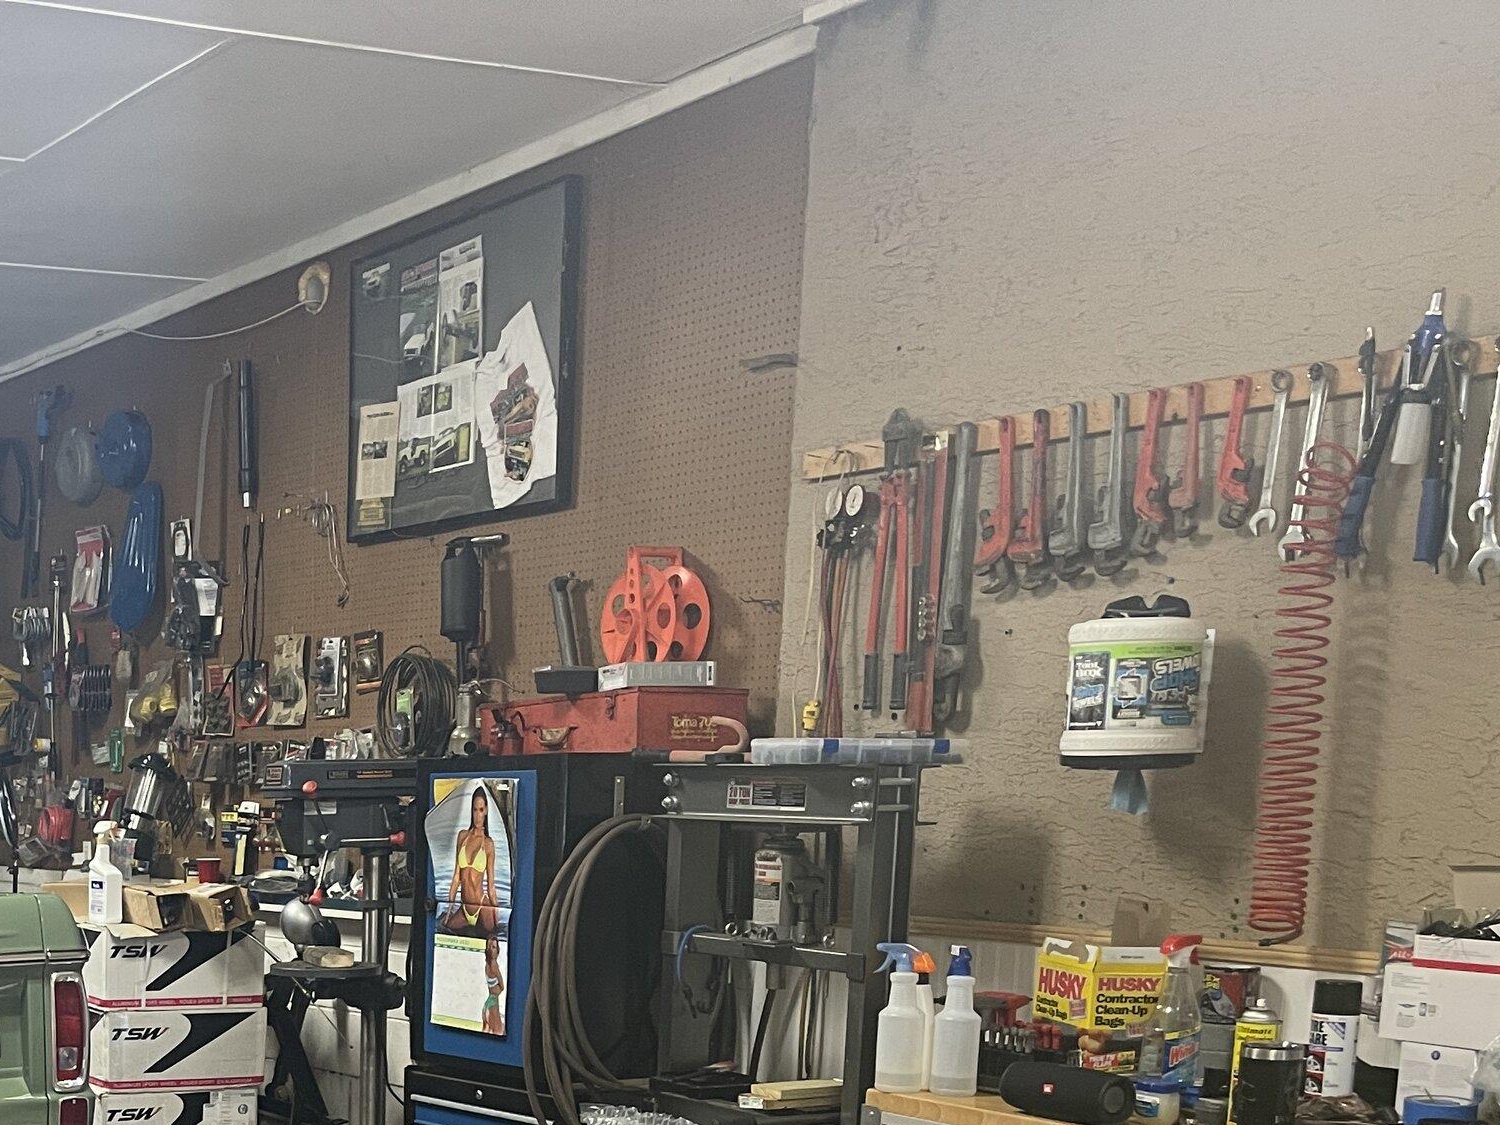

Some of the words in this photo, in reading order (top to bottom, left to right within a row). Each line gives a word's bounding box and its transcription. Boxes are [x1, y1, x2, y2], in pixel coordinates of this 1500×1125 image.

[110, 945, 168, 959] TSW
[1038, 967, 1087, 1000] HUSKY
[1097, 977, 1162, 992] HUSKY
[1095, 1005, 1148, 1017] Clean-Up
[1094, 1016, 1125, 1028] Bags
[112, 1027, 171, 1041] TSW
[107, 1106, 164, 1122] TSW
